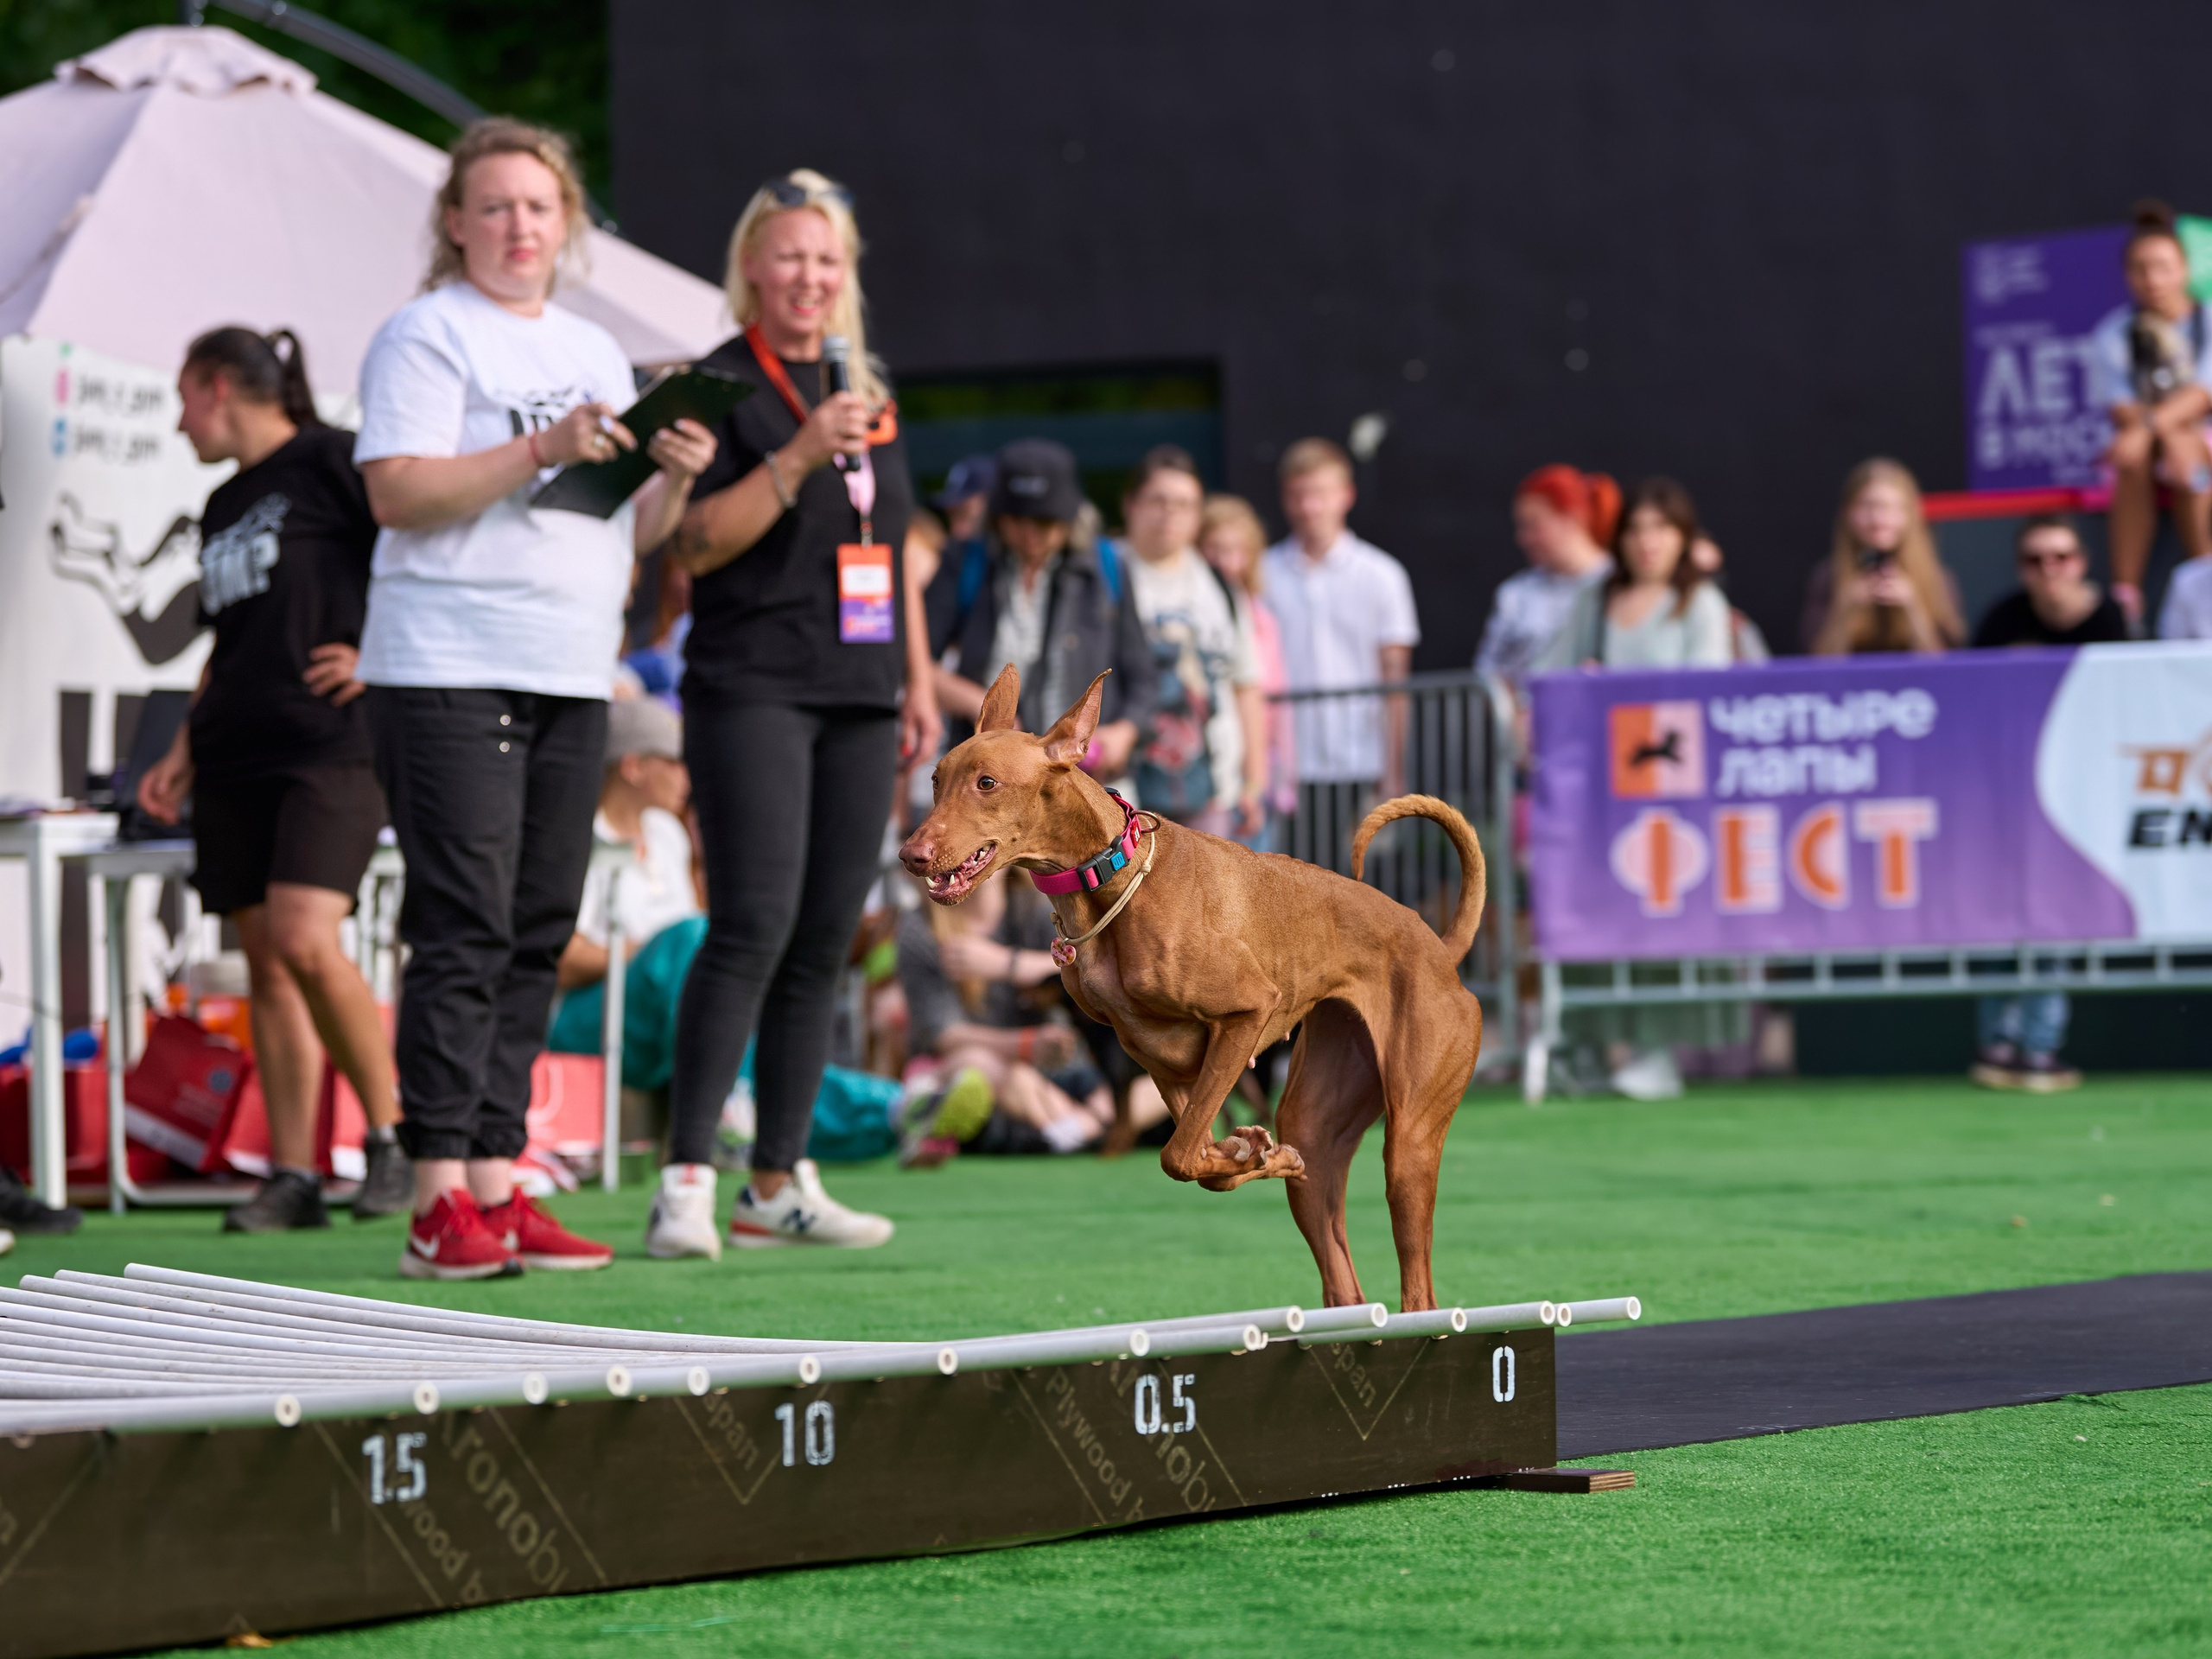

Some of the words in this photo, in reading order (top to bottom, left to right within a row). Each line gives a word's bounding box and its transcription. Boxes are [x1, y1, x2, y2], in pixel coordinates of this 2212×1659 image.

[1710, 688, 1937, 742] четыре
[1716, 743, 1877, 798] лапы
[1609, 798, 1939, 918] ФЕСТ
[1492, 1345, 1516, 1402] 0
[1135, 1373, 1196, 1435] 0.5
[361, 1431, 428, 1505] 1.5
